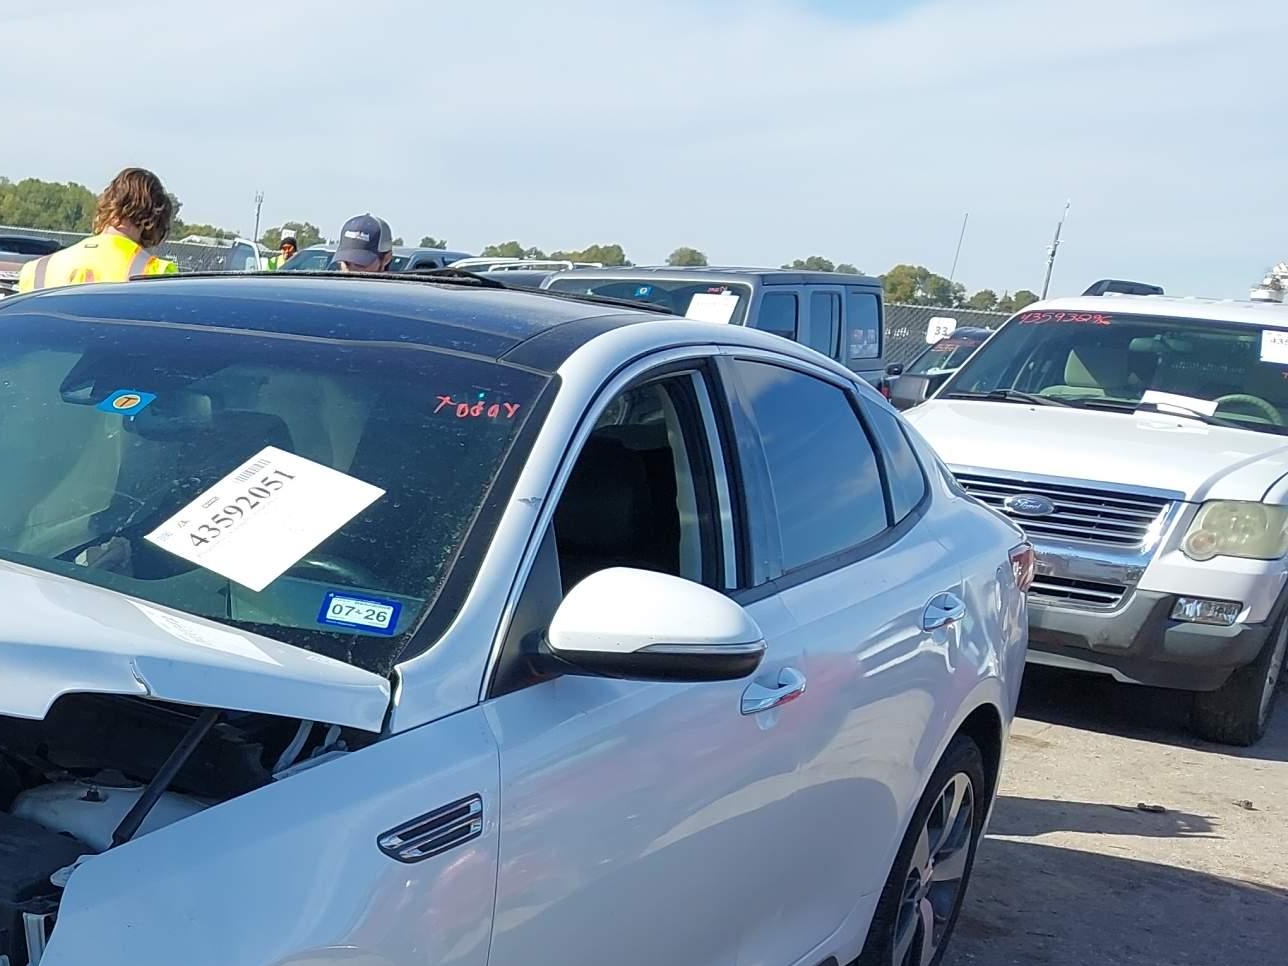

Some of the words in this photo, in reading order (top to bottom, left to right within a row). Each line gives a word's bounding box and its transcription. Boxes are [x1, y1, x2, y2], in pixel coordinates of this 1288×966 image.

[934, 326, 948, 336] 33
[189, 469, 296, 547] 43592051
[331, 603, 356, 617] 07
[363, 608, 388, 623] 26
